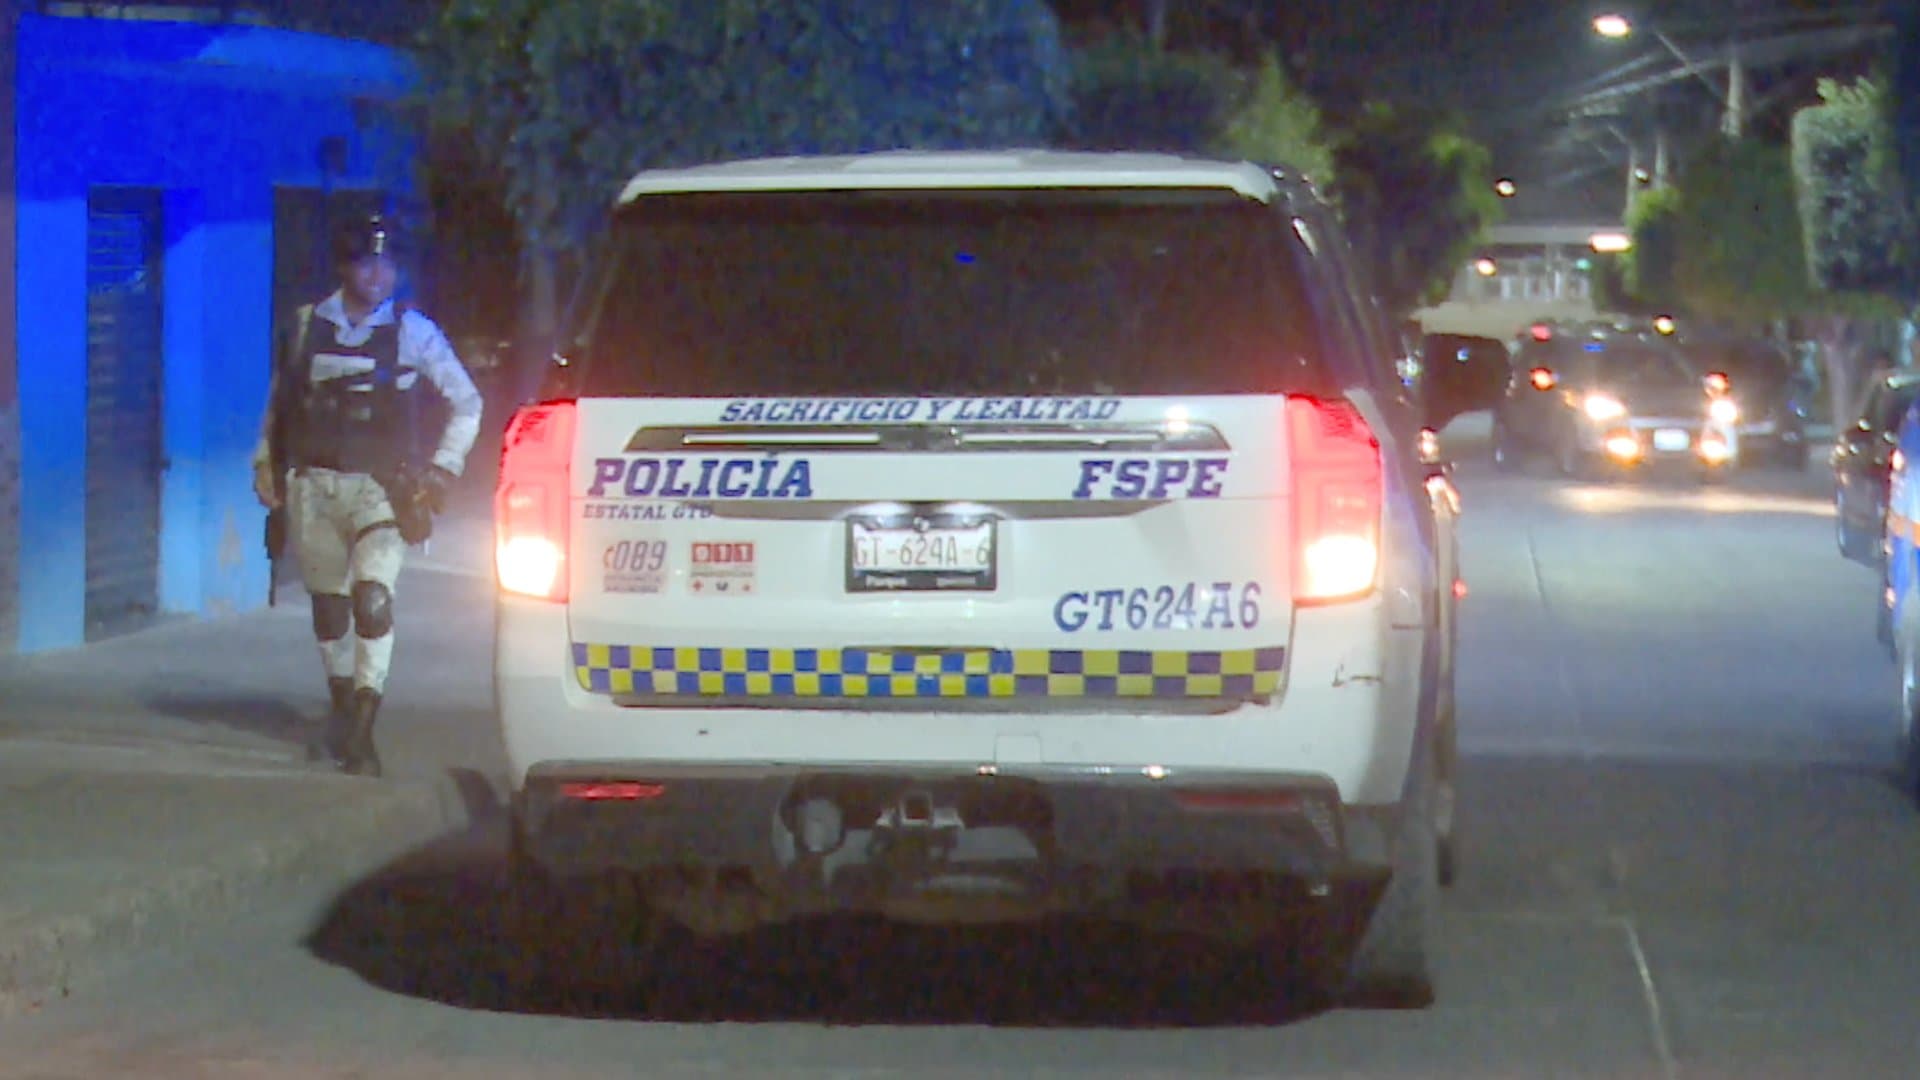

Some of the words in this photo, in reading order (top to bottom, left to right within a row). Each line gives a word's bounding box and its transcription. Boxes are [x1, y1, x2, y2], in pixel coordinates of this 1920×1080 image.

[719, 399, 916, 424] SACRIFICIO
[924, 399, 955, 422] Y
[954, 399, 1122, 422] LEALTAD
[588, 450, 813, 498] POLICÍA
[1073, 458, 1230, 499] FSPE
[583, 503, 667, 520] ESTATAL
[613, 539, 668, 572] 089
[853, 534, 991, 567] GT-624A-6
